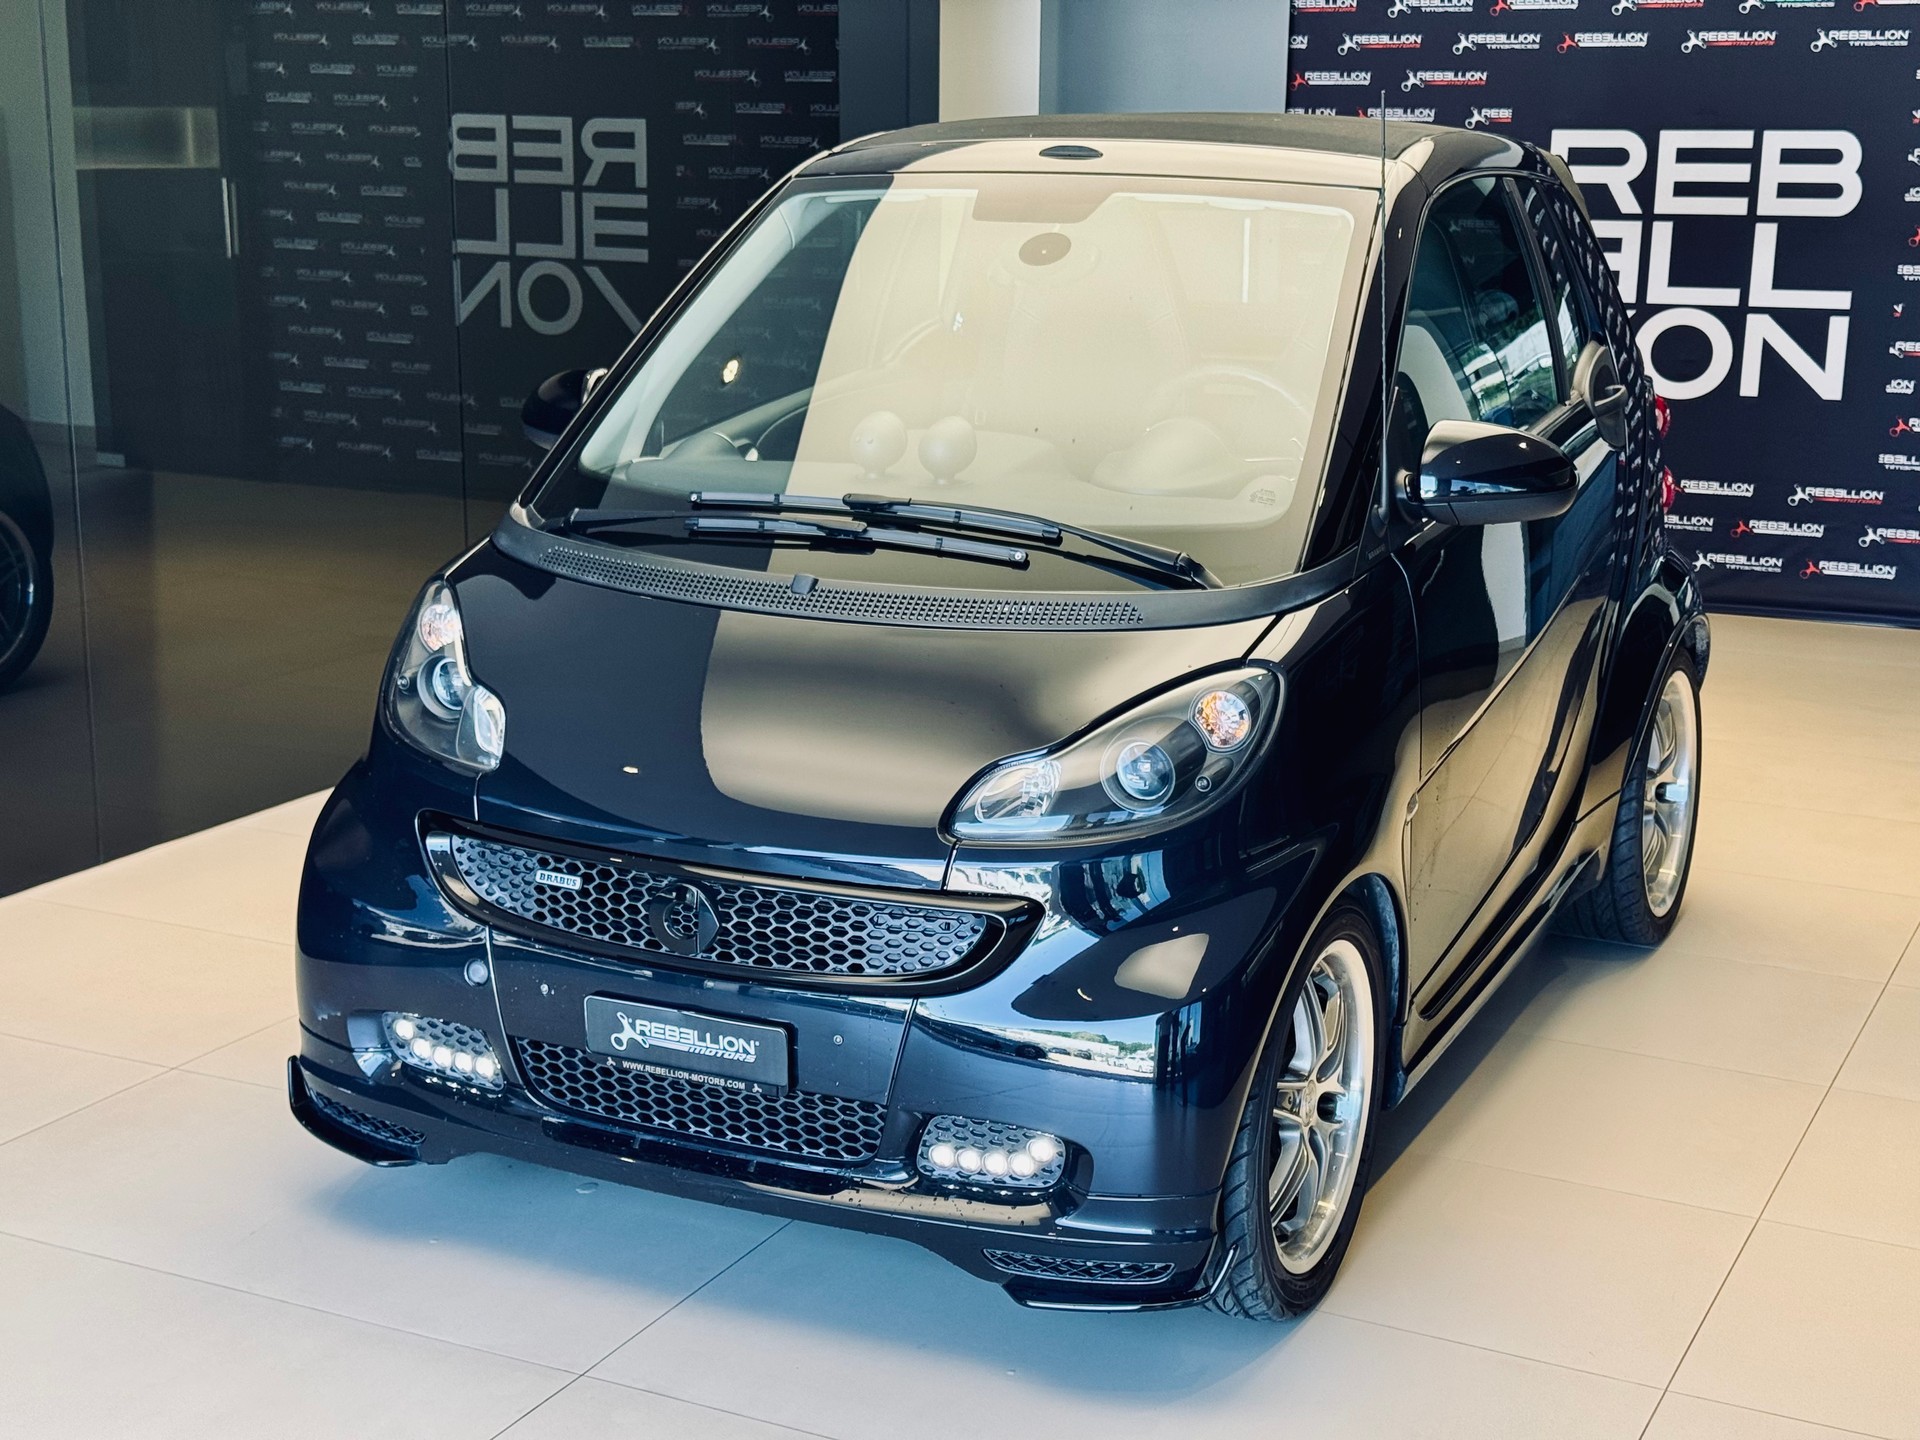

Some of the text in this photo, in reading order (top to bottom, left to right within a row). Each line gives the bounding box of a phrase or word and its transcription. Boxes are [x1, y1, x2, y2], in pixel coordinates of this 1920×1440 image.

[1352, 34, 1422, 44] REBELLION
[1468, 33, 1541, 43] REBELLION
[1574, 32, 1648, 43] REBELLION
[1698, 31, 1777, 41] REBELLION
[1828, 30, 1910, 40] REBELLION
[1304, 71, 1371, 82] REBELLION
[1416, 71, 1487, 82] REBELLION
[1550, 128, 1863, 217] REB
[1628, 307, 1850, 401] ON
[1680, 479, 1754, 493] REBELLION
[1805, 487, 1884, 501] REBELLION
[1749, 520, 1825, 534] REBELLION
[1707, 553, 1783, 567] REBELLION
[1818, 560, 1897, 575] REBELLION
[539, 872, 578, 887] BRABUS
[635, 1019, 755, 1055] REBELLION
[688, 1046, 757, 1063] MOTORS
[622, 1060, 746, 1090] WWW.REBELLION-MOTORS.COM
